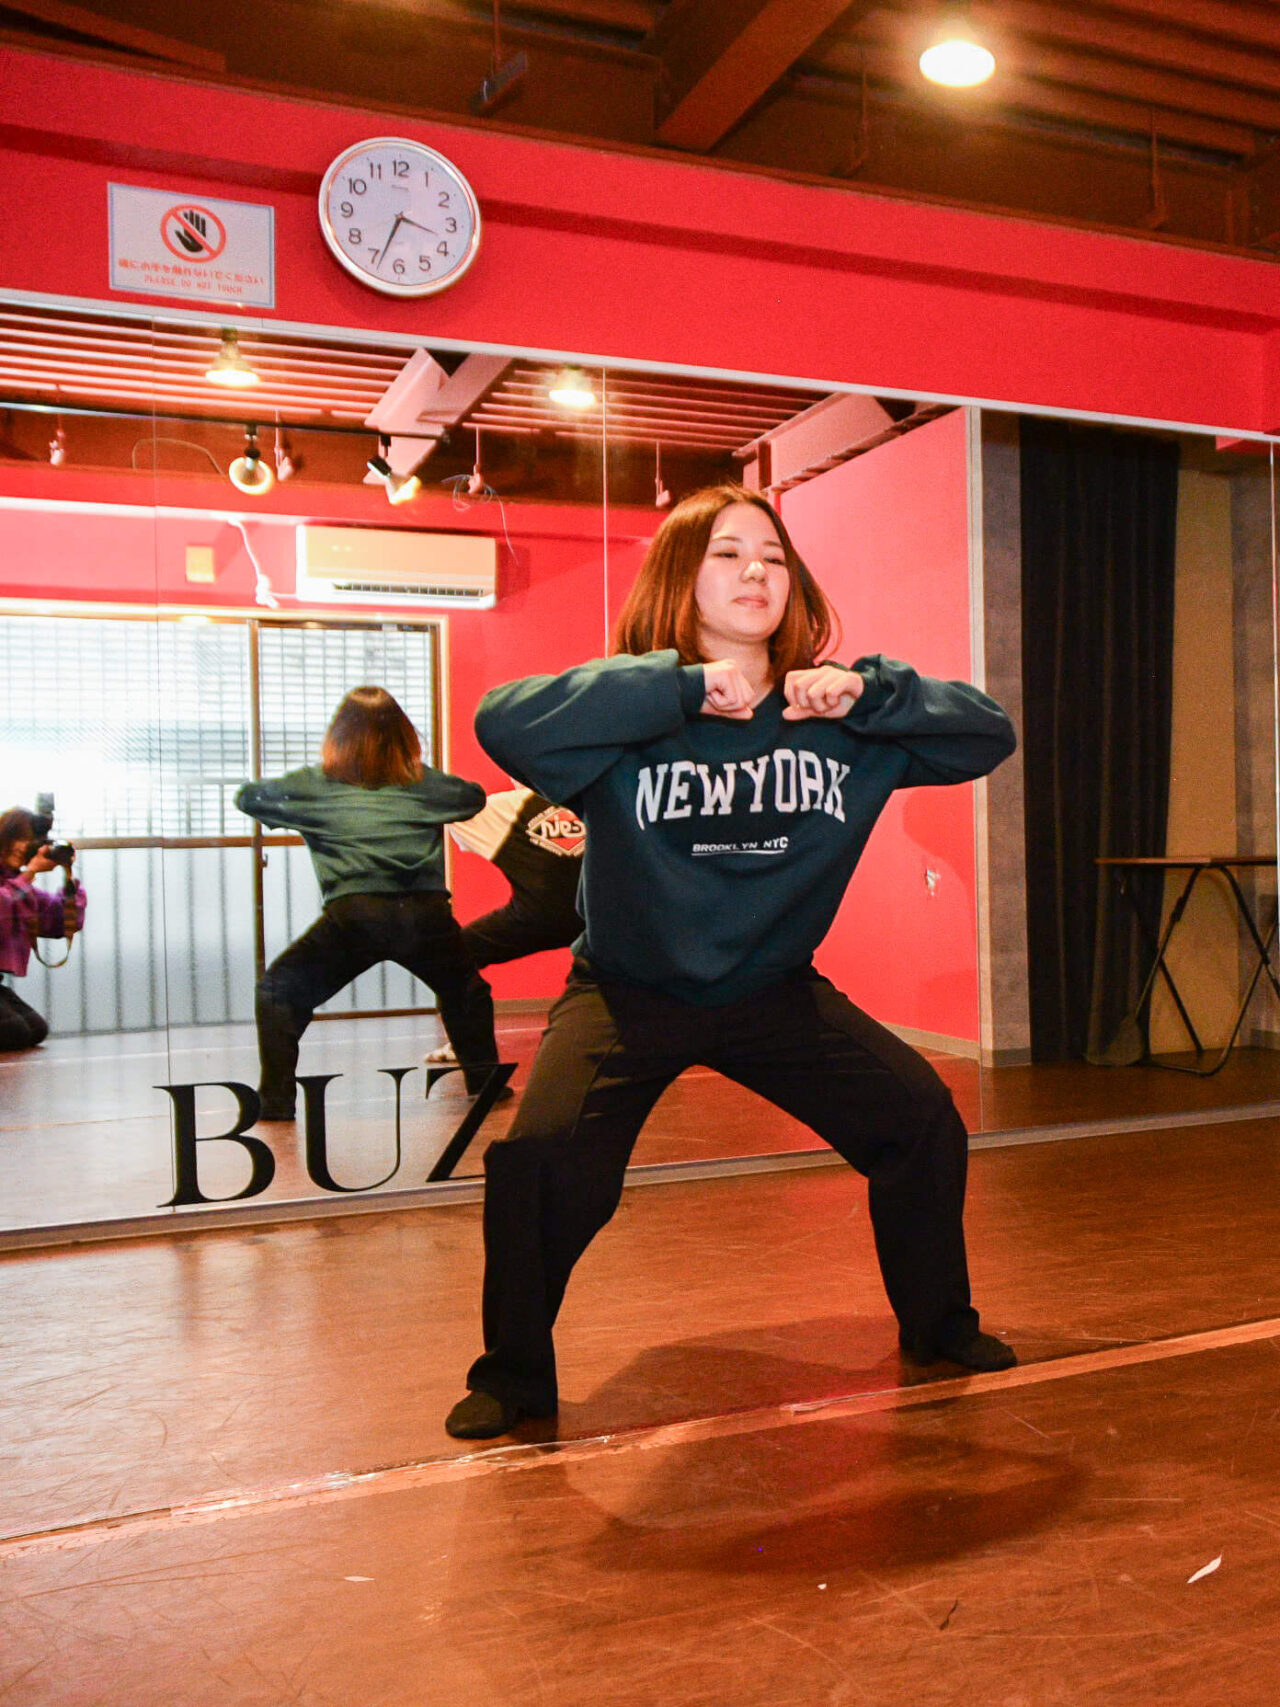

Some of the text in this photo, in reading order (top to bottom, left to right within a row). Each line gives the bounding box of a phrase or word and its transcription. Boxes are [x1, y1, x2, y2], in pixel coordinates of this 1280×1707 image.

[369, 162, 382, 180] 11
[392, 159, 410, 177] 12
[348, 178, 367, 196] 10
[438, 191, 450, 208] 2
[340, 201, 354, 218] 9
[445, 217, 457, 233] 3
[348, 227, 362, 245] 8
[367, 247, 380, 264] 7
[436, 240, 449, 257] 4
[392, 258, 405, 275] 6
[418, 255, 431, 272] 5
[635, 748, 851, 831] NEW YORK
[692, 836, 789, 853] BROOKLYN NYC
